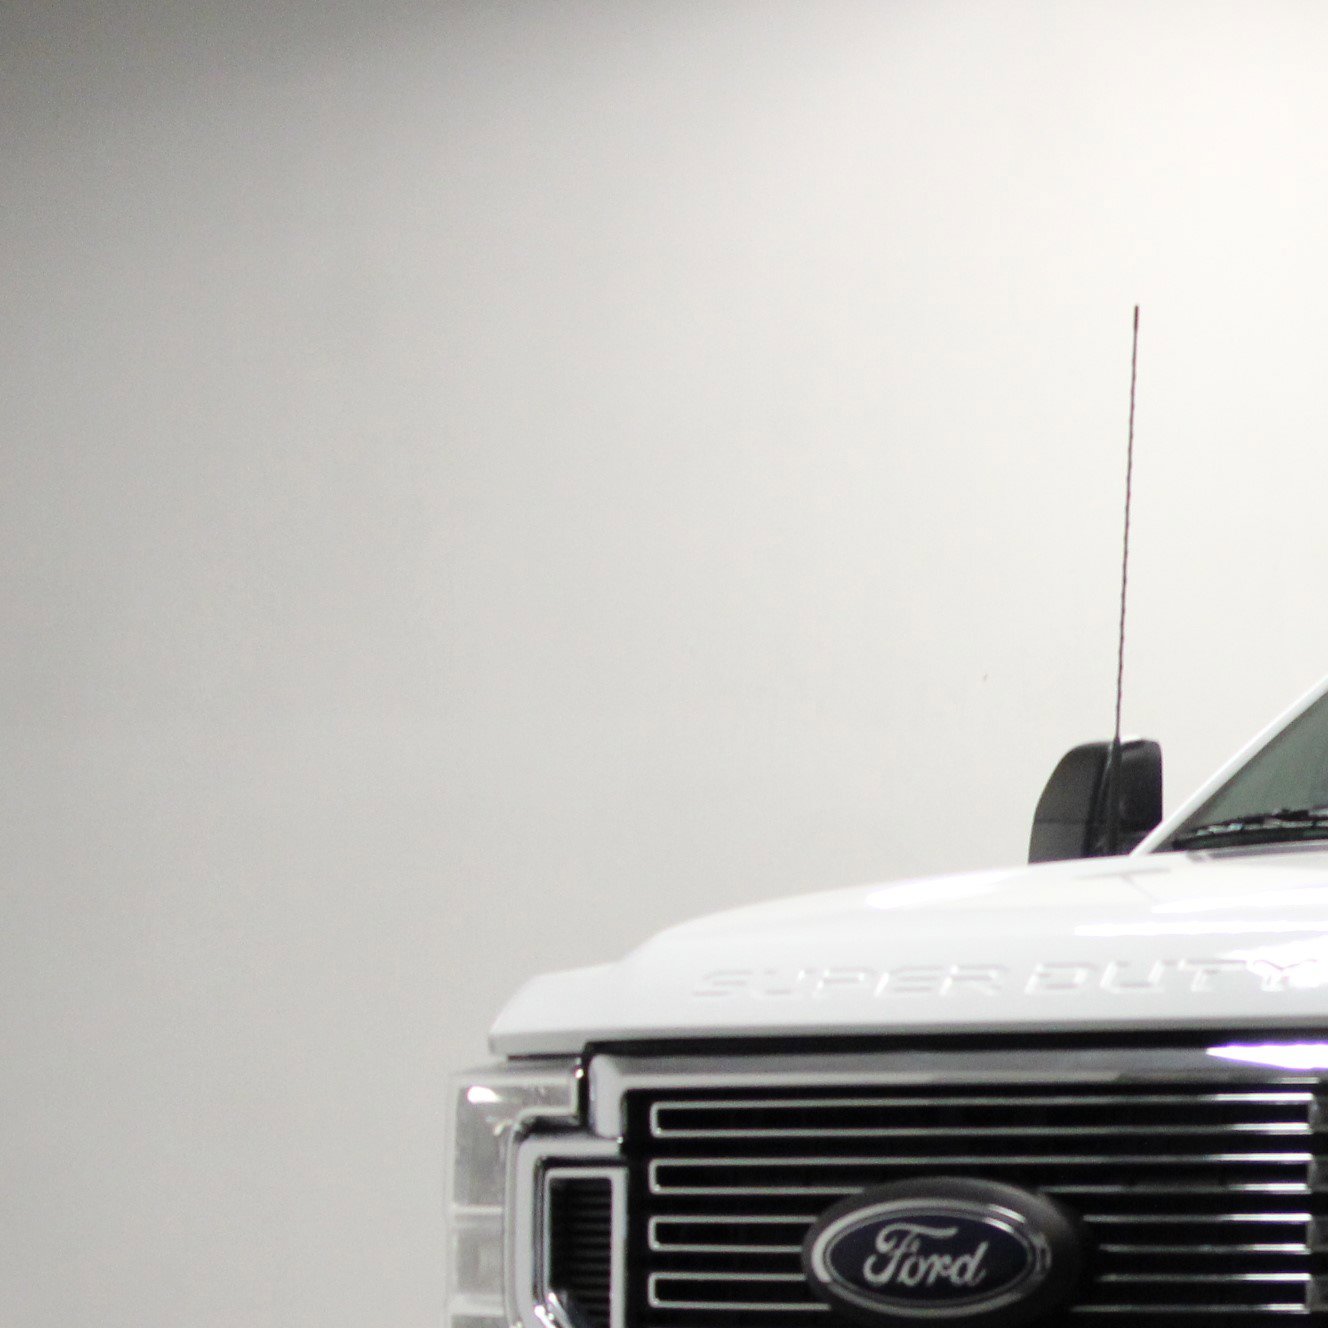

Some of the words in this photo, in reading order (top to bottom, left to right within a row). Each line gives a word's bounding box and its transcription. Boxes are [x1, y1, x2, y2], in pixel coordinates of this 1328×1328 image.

[692, 962, 1009, 999] SUPER
[1022, 956, 1318, 996] DUTY
[863, 1222, 988, 1286] Ford
